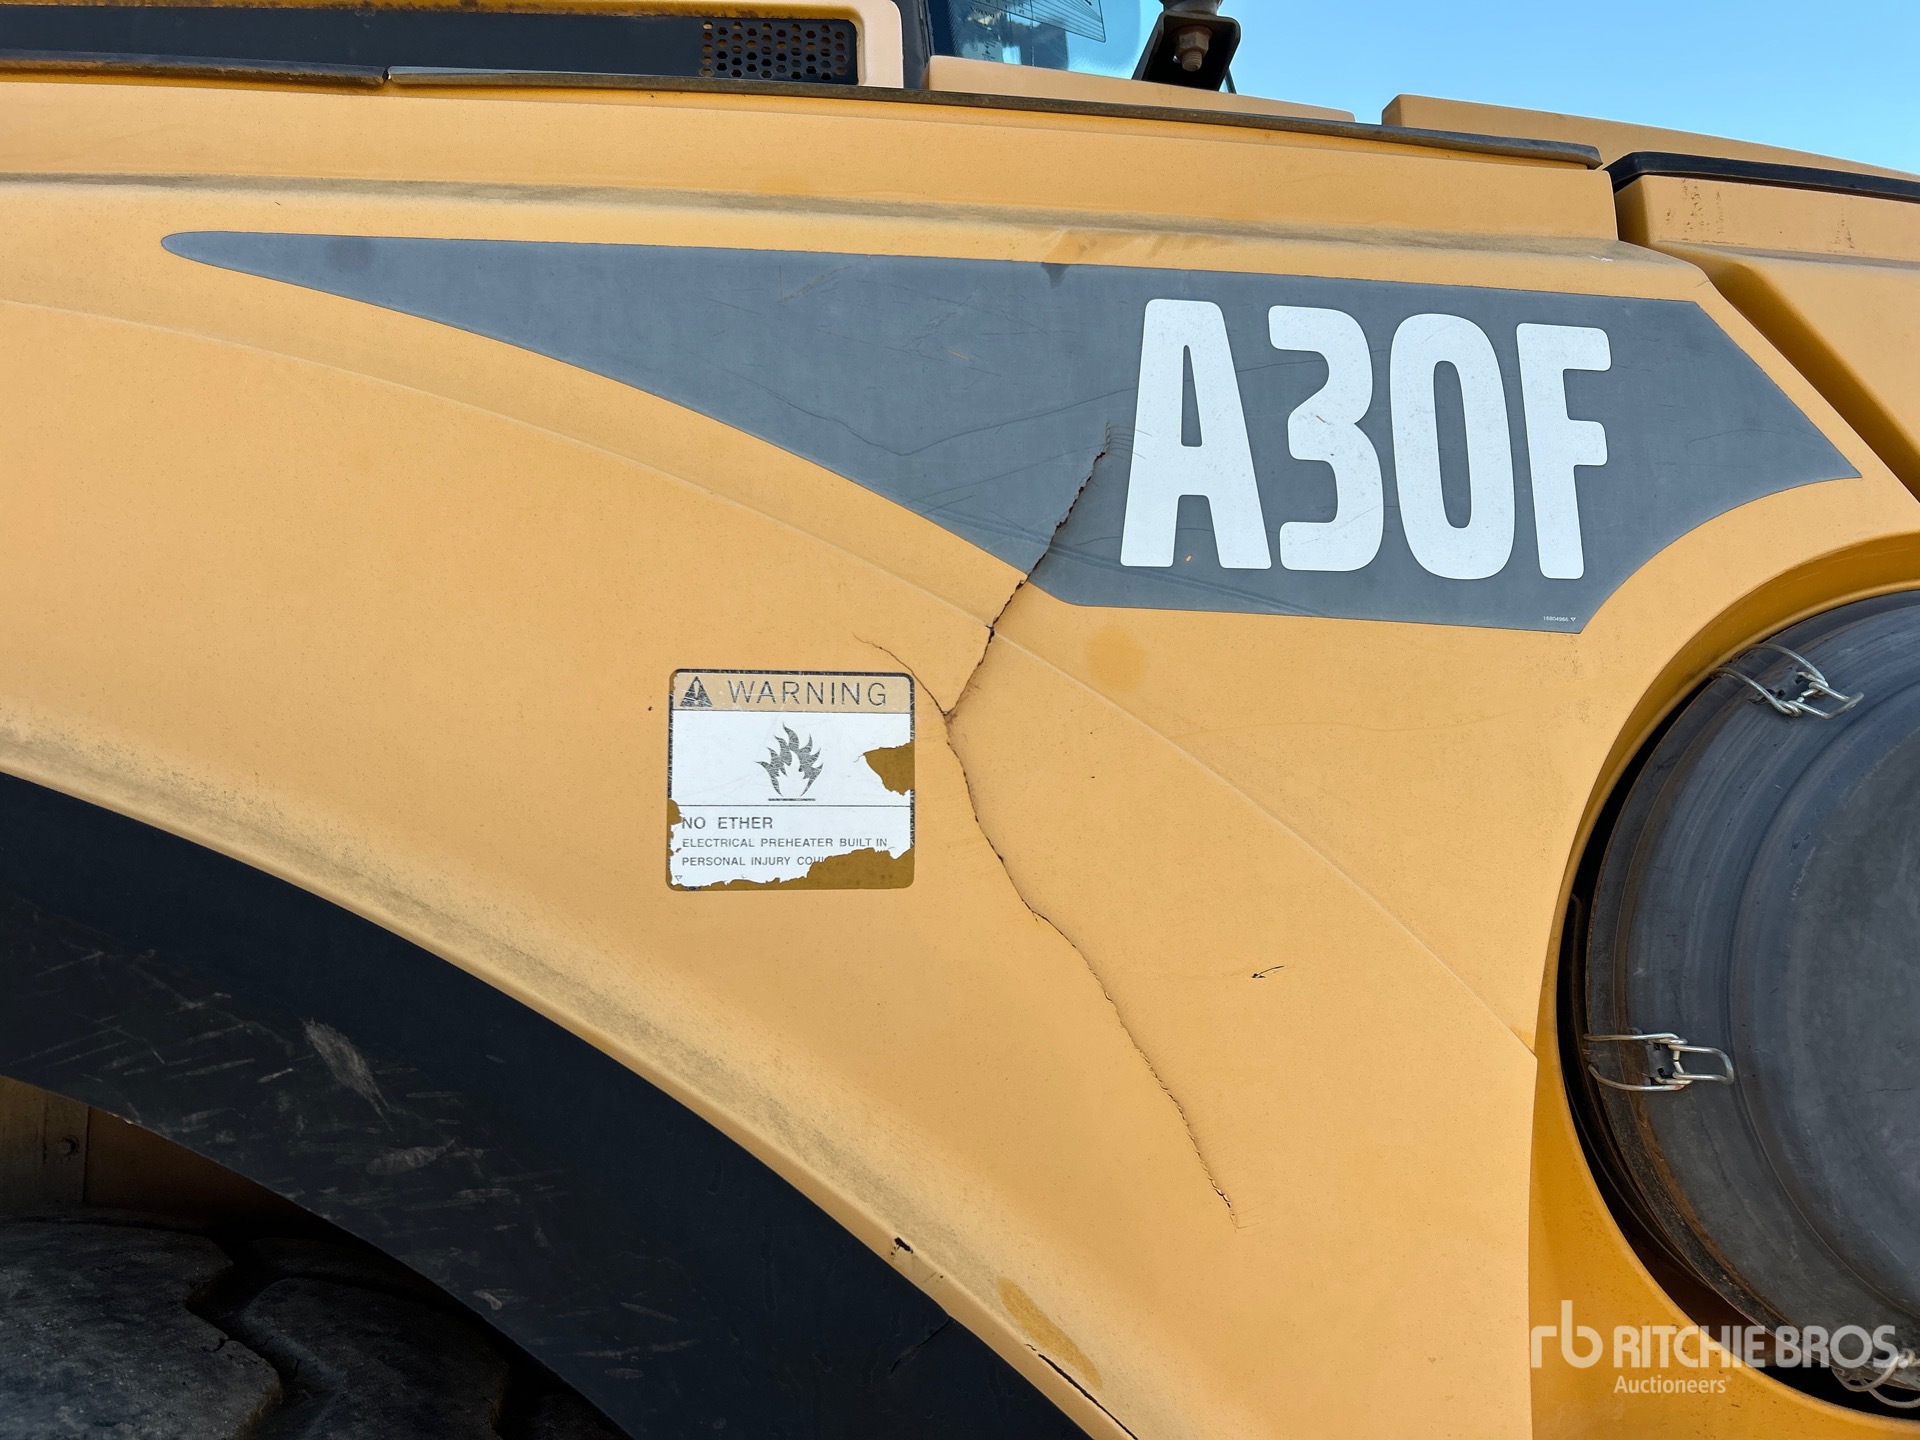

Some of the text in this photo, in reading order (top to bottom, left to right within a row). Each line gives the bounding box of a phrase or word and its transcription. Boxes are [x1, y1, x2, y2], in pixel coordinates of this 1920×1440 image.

[1120, 298, 1612, 580] A30F
[727, 680, 887, 706] WARNING
[682, 816, 773, 829] NO ETHER
[682, 837, 888, 848] ELECTRICAL PREHEATER BUILT IN
[682, 856, 746, 866] PERSONAL
[751, 856, 790, 866] INJURY
